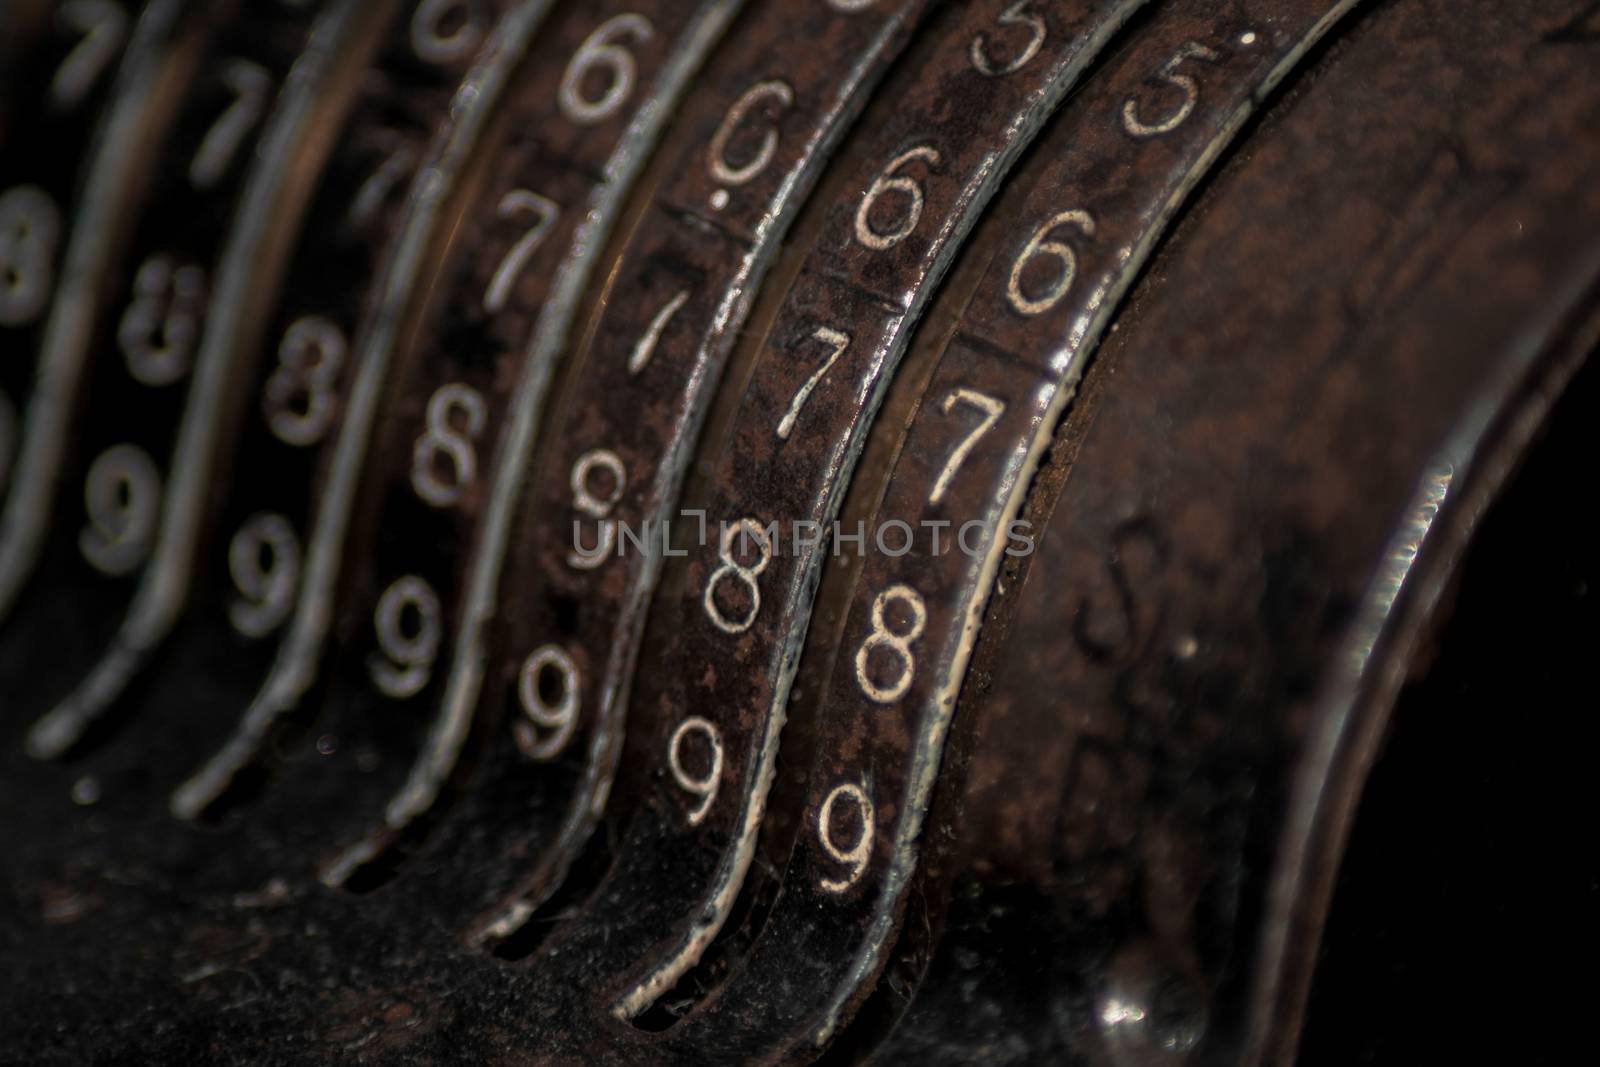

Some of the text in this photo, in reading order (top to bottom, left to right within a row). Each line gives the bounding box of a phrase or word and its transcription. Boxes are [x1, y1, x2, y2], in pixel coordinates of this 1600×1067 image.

[188, 57, 271, 188] 7
[559, 13, 653, 123] 6
[1122, 40, 1218, 137] 5
[708, 79, 793, 186] 6
[484, 189, 560, 313] 7
[853, 145, 940, 250] 6
[1007, 209, 1096, 316] 6
[264, 313, 348, 447] 8
[776, 327, 850, 439] 7
[411, 382, 487, 507] 8
[928, 388, 1005, 505] 7
[78, 442, 164, 576] 9
[227, 509, 300, 640] 9
[704, 517, 772, 635] 8
[368, 573, 443, 698] 9
[855, 583, 928, 704] 8
[514, 643, 583, 762] 9
[667, 716, 724, 826] 9
[818, 782, 876, 894] 9
